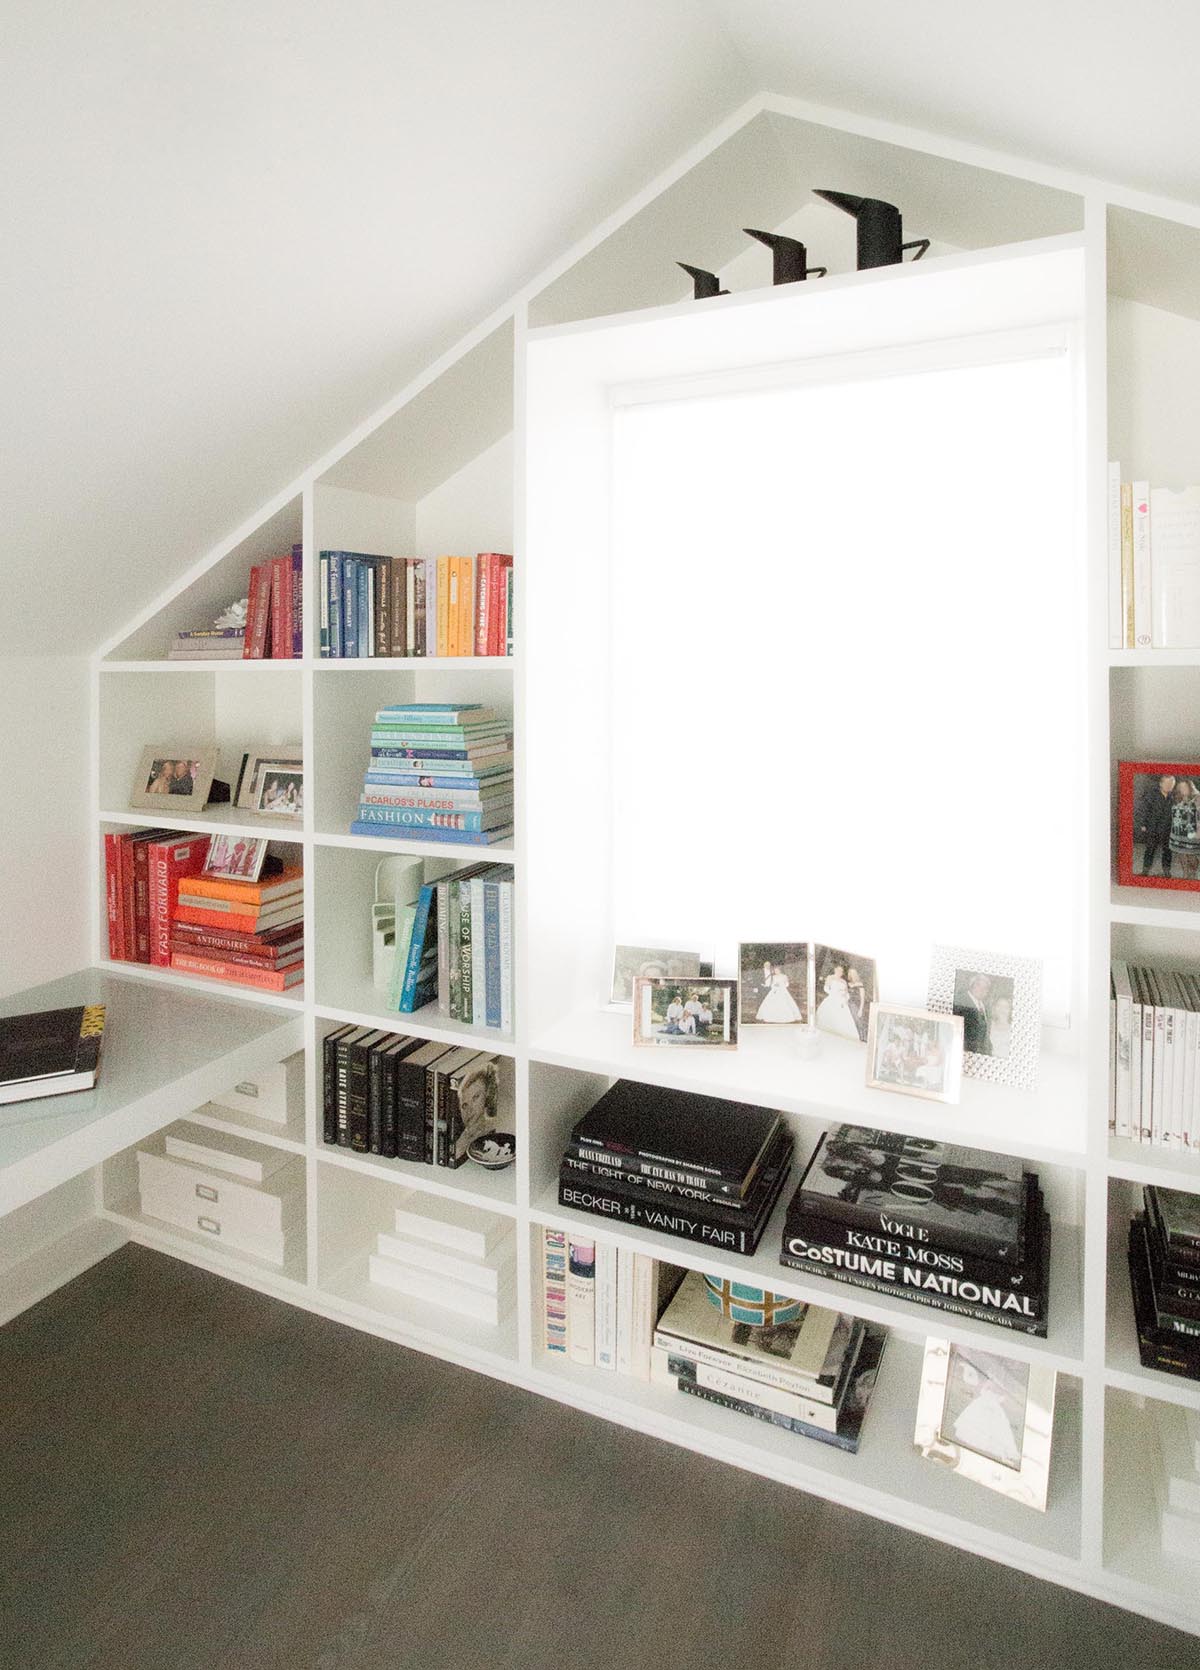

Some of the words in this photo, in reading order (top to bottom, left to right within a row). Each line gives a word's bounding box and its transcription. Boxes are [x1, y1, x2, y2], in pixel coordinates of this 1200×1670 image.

[360, 808, 425, 824] FASHION
[417, 798, 454, 809] PLACES
[157, 861, 168, 922] FORWARD
[438, 886, 448, 934] BECOMING
[158, 922, 169, 956] FAST
[196, 935, 249, 949] ANTIQUAIRES
[461, 926, 470, 941] OF
[461, 944, 472, 993] WORSHIP
[338, 1068, 347, 1088] KATE
[338, 1090, 347, 1130] ATKINSON
[567, 1158, 589, 1171] THE
[592, 1165, 624, 1180] LIGHT
[627, 1174, 643, 1185] OF
[647, 1179, 674, 1193] NEW
[676, 1186, 711, 1203] YORK
[563, 1188, 621, 1215] BECKER
[644, 1209, 698, 1235] VANITY
[702, 1225, 735, 1246] FAIR
[880, 1212, 929, 1243] VOGUE
[845, 1230, 901, 1257] KATE
[903, 1246, 964, 1273] MOSS
[877, 1284, 931, 1305] PHOTOGRAPHS
[932, 1298, 942, 1308] BY
[943, 1301, 974, 1316] JOHNNY
[974, 1310, 1013, 1327] MONCADA
[903, 1266, 1035, 1317] NATIONAL
[679, 1345, 698, 1358] Live
[699, 1350, 732, 1367] Forever
